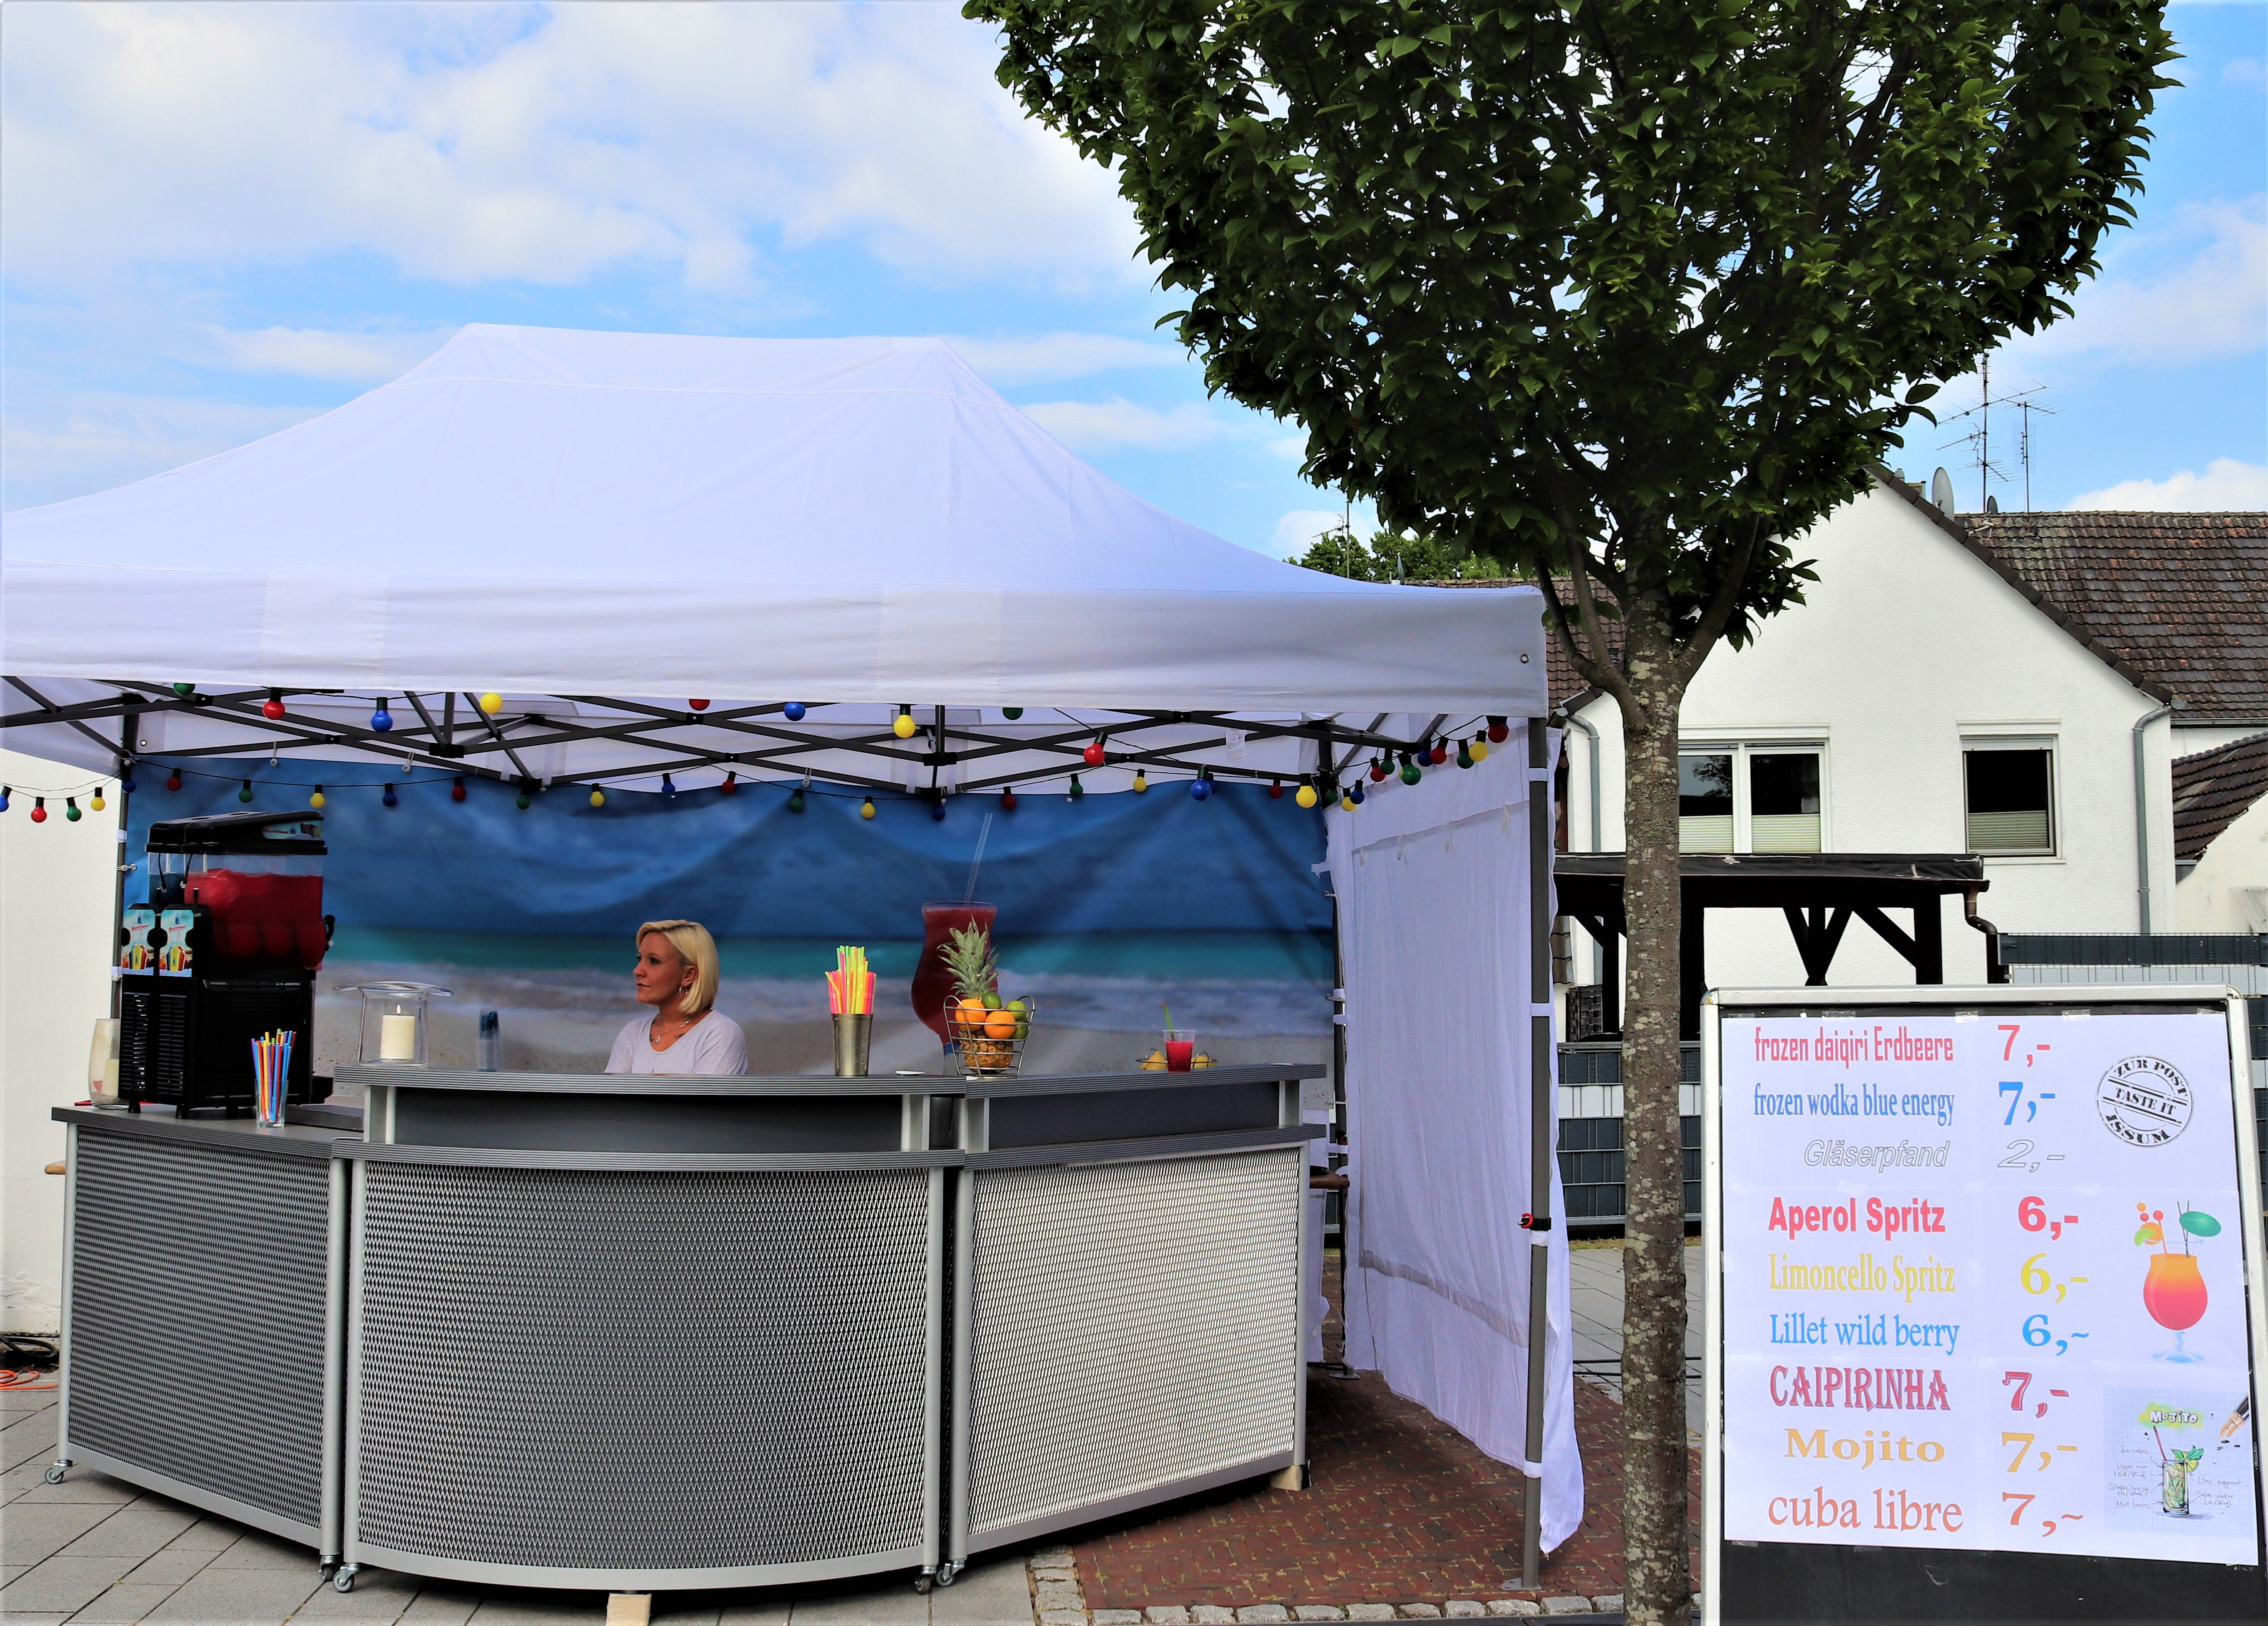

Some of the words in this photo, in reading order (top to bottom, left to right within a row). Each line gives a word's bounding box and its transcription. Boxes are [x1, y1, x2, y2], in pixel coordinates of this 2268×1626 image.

[1755, 1026, 1809, 1061] frozen
[1815, 1026, 1868, 1069] daiqiri
[1874, 1026, 1954, 1061] Erdbeere
[1997, 1025, 2051, 1068] 7,-
[2113, 1059, 2148, 1077] ZUR
[2153, 1061, 2188, 1097] POST
[1753, 1082, 1804, 1116] frozen
[1807, 1082, 1859, 1116] wodka
[1862, 1082, 1897, 1116] blue
[1902, 1094, 1955, 1127] energy
[1998, 1082, 2056, 1126] 7,-
[2114, 1087, 2157, 1110] TASTE
[2160, 1102, 2176, 1116] IT
[2105, 1113, 2171, 1144] ISSUM
[1804, 1139, 1951, 1173] Gläserpfand
[1768, 1197, 1857, 1240] Aperol
[1866, 1197, 1946, 1241] Spritz
[2018, 1196, 2079, 1241] 6,-
[1769, 1253, 1887, 1292] Limoncello
[1892, 1255, 1956, 1304] Spritz
[2020, 1253, 2088, 1304] 6,-
[1770, 1312, 1828, 1344] Lillet
[1834, 1313, 1888, 1346] wild
[1893, 1314, 1961, 1356] berry
[1769, 1365, 1951, 1412] CAIPIRINHA
[2001, 1371, 2070, 1418] 7,-
[1784, 1428, 1945, 1469] Mojito
[2001, 1431, 2078, 1473] 7,-
[2116, 1499, 2130, 1507] Mint
[2197, 1476, 2213, 1485] Lime
[2217, 1479, 2243, 1489] segment
[1768, 1486, 1861, 1528] cuba
[1873, 1488, 1963, 1532] libre
